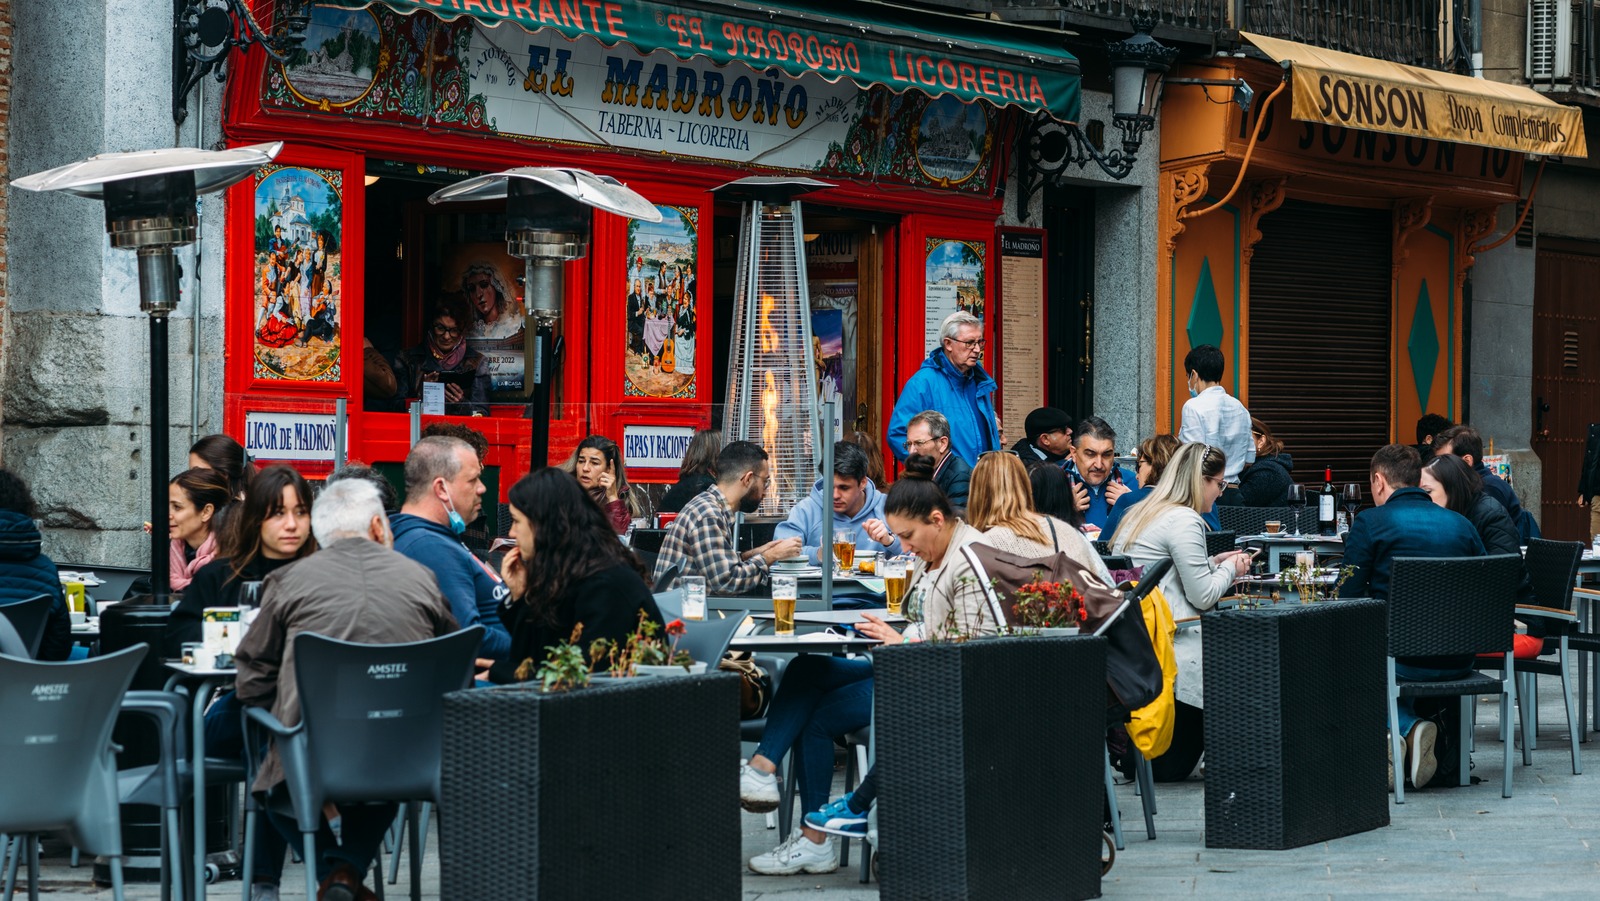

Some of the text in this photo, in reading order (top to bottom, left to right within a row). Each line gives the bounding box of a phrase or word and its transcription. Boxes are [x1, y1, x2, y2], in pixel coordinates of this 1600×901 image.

[667, 13, 712, 50] EL
[722, 22, 860, 74] MADROÑO
[888, 50, 1048, 107] LICORERIA
[523, 45, 808, 129] EL MADROÑO
[1318, 75, 1566, 144] SONSON Ropa Complementos
[598, 111, 663, 140] TABERNA
[677, 121, 750, 151] LICORERIA
[1005, 240, 1011, 249] EL
[1011, 241, 1040, 251] MADROÑO
[501, 356, 515, 364] 2022
[246, 419, 337, 451] LICOR DE MADROÑ
[625, 434, 649, 459] TAPAS
[649, 435, 655, 458] Y
[367, 662, 409, 675] AMSTEL
[31, 683, 70, 696] AMSTEL
